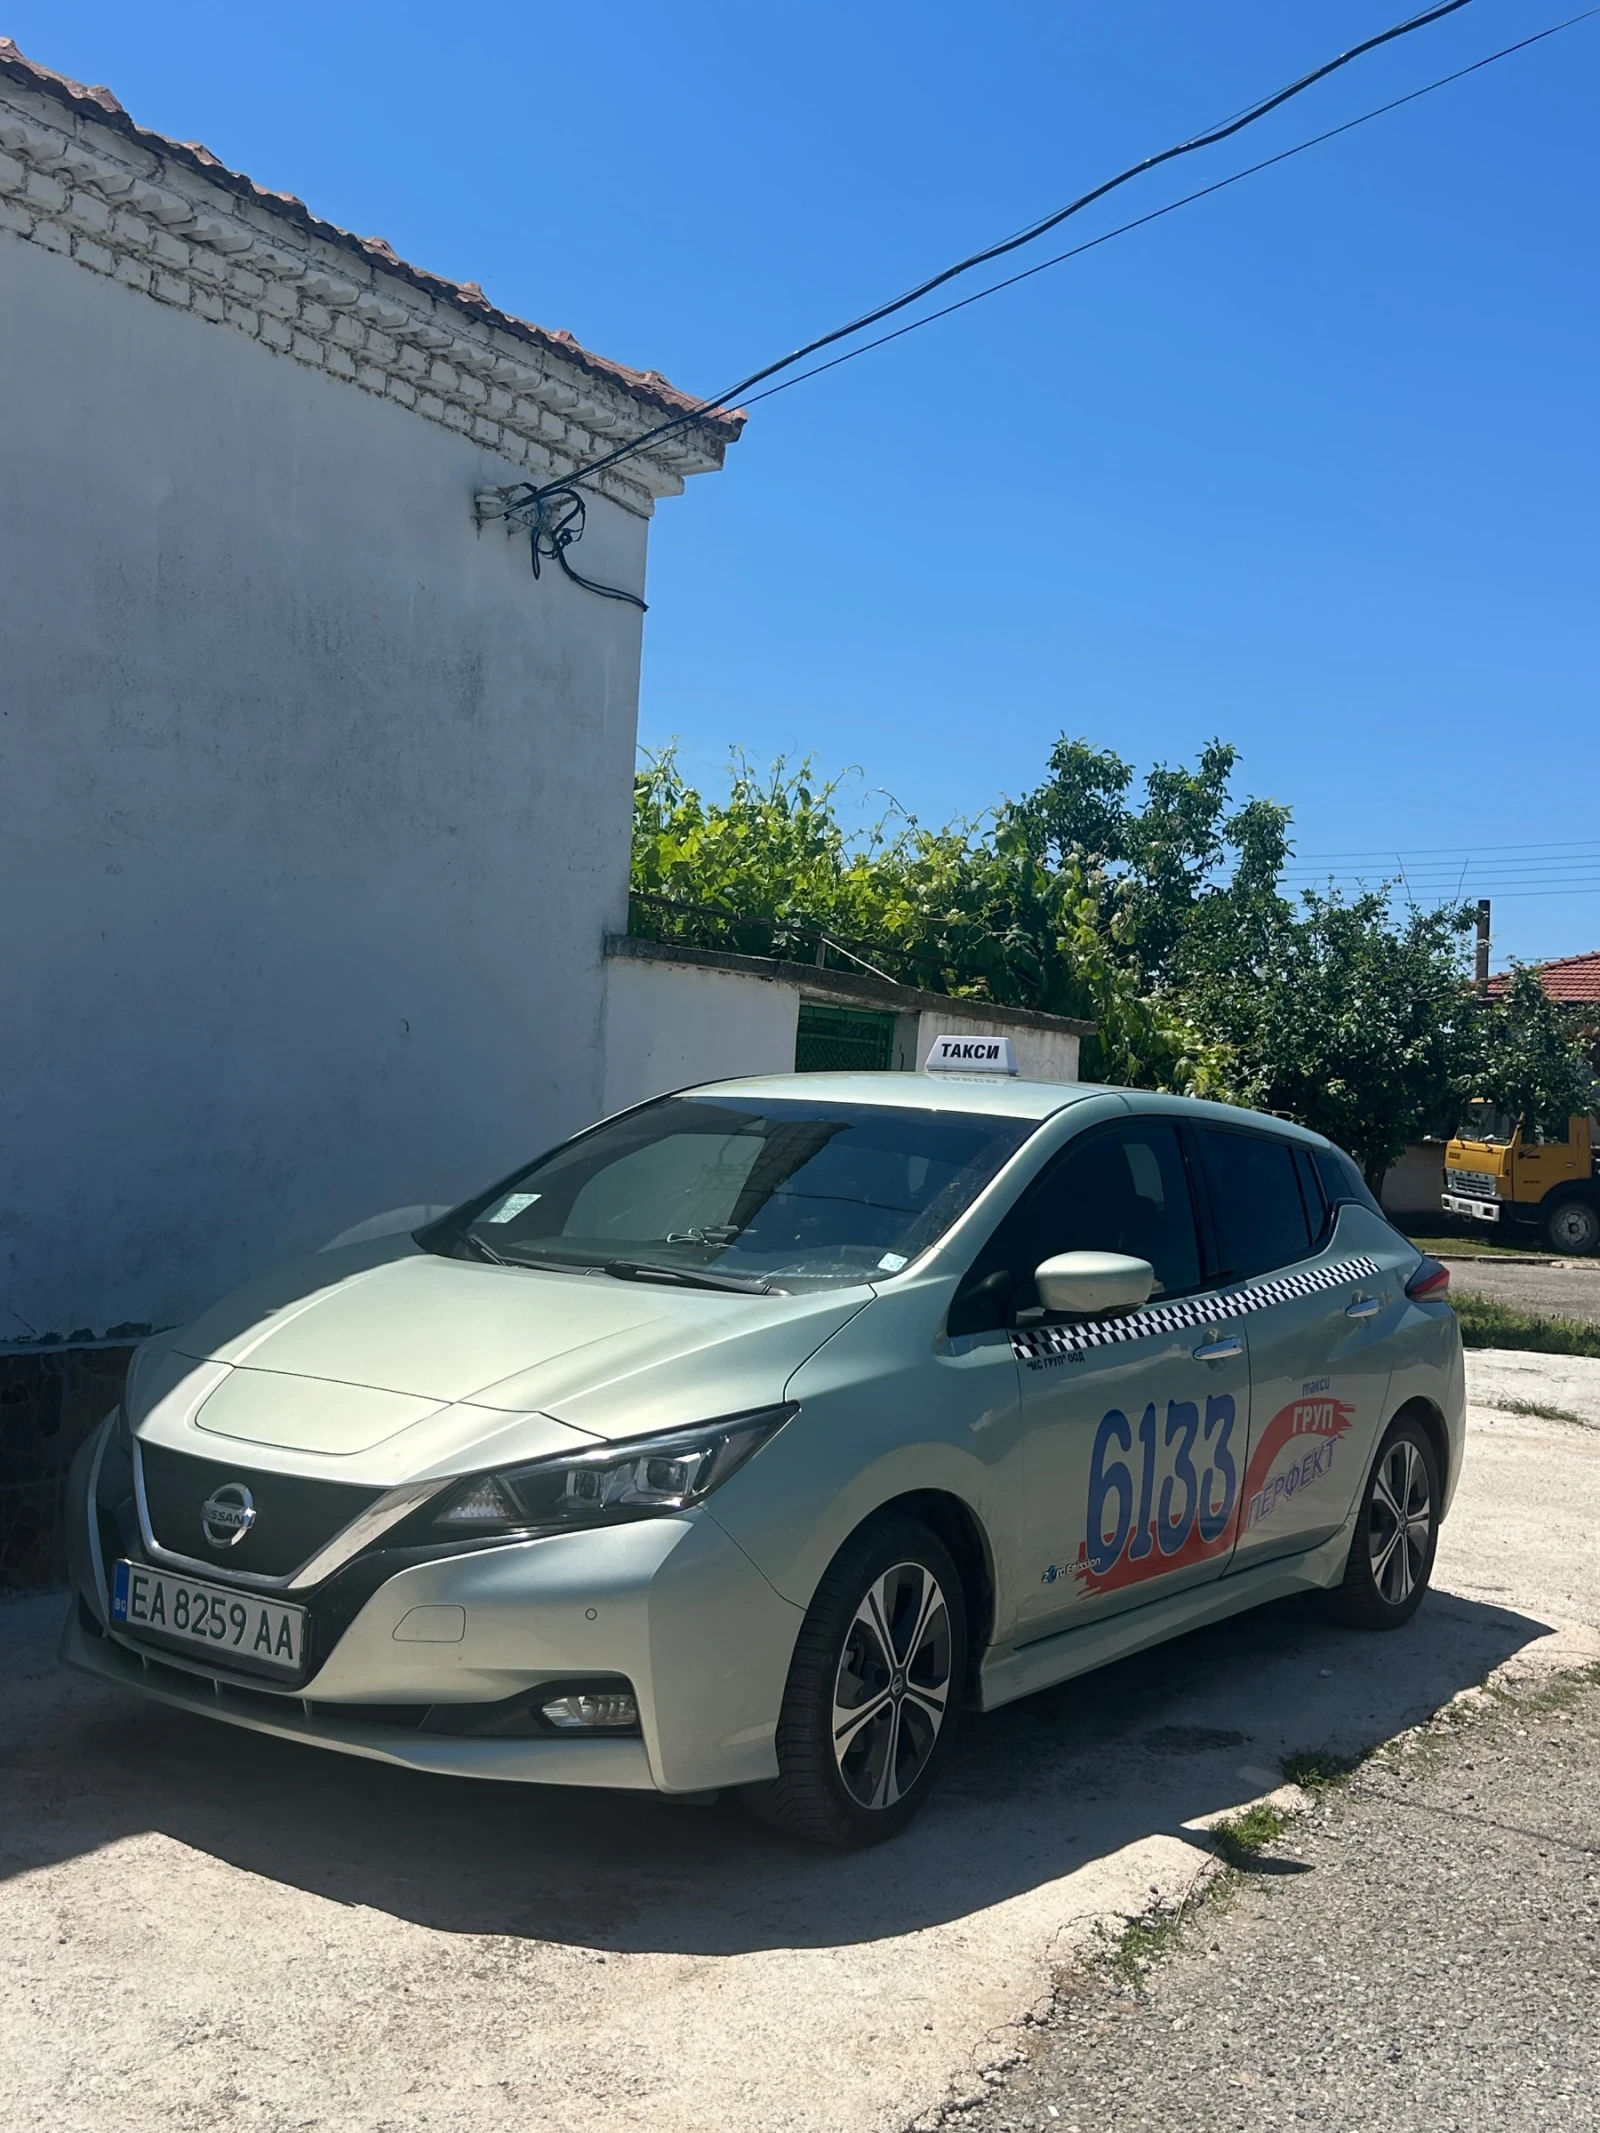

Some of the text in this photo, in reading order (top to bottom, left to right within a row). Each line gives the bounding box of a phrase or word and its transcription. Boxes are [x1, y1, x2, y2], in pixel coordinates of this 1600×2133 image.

[941, 1043, 1000, 1060] ТАКСИ
[1068, 1351, 1086, 1363] ООД
[1302, 1376, 1331, 1397] такси
[1292, 1403, 1334, 1434] ГРУП
[1086, 1393, 1237, 1576] 6133
[1246, 1435, 1339, 1529] ПЕРФЕКТ
[204, 1506, 244, 1525] NISSAN
[115, 1597, 127, 1613] BG
[131, 1575, 293, 1660] EA 8259 AA
